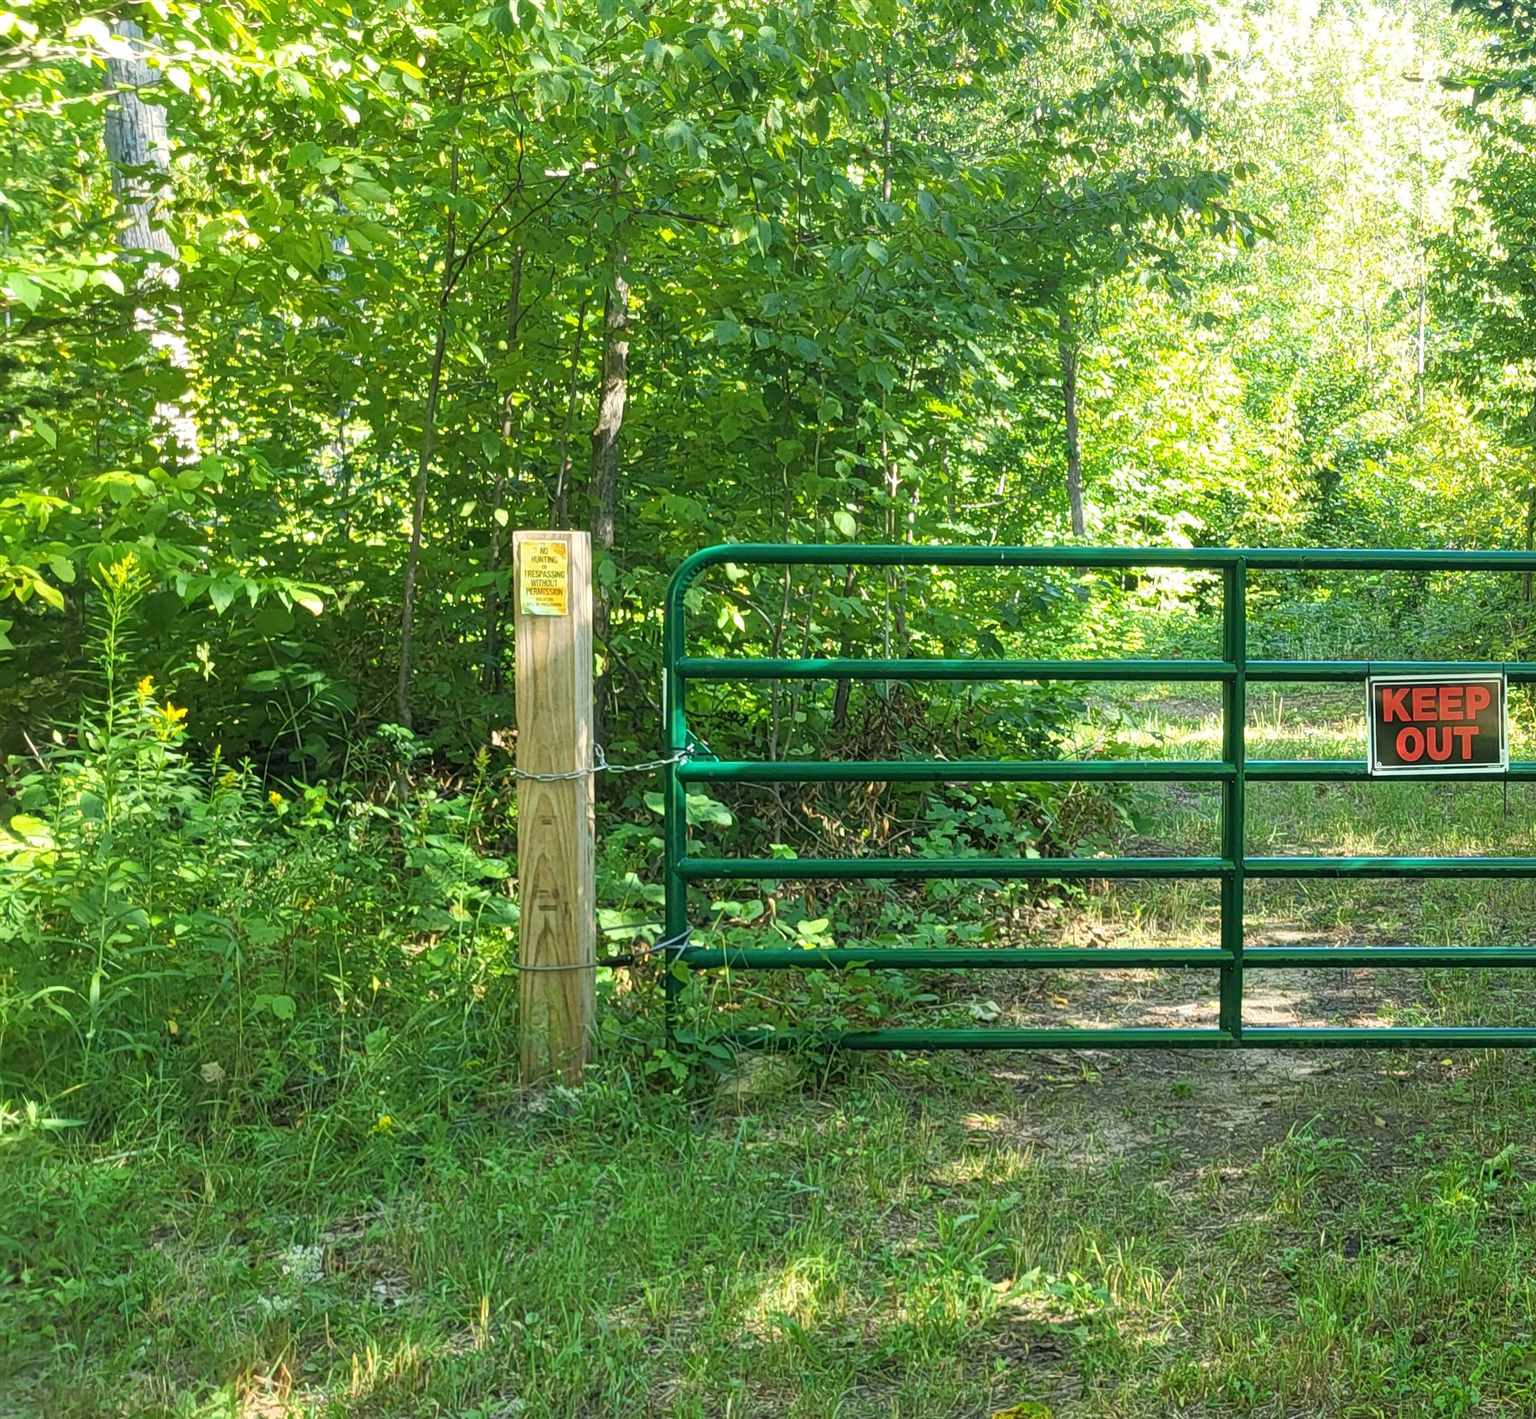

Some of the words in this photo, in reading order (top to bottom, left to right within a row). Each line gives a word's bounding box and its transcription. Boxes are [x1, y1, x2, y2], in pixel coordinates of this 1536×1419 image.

[524, 570, 565, 578] TRESPASSING
[531, 579, 558, 587] WITHOUT
[1382, 686, 1491, 722] KEEP
[1396, 725, 1480, 762] OUT
